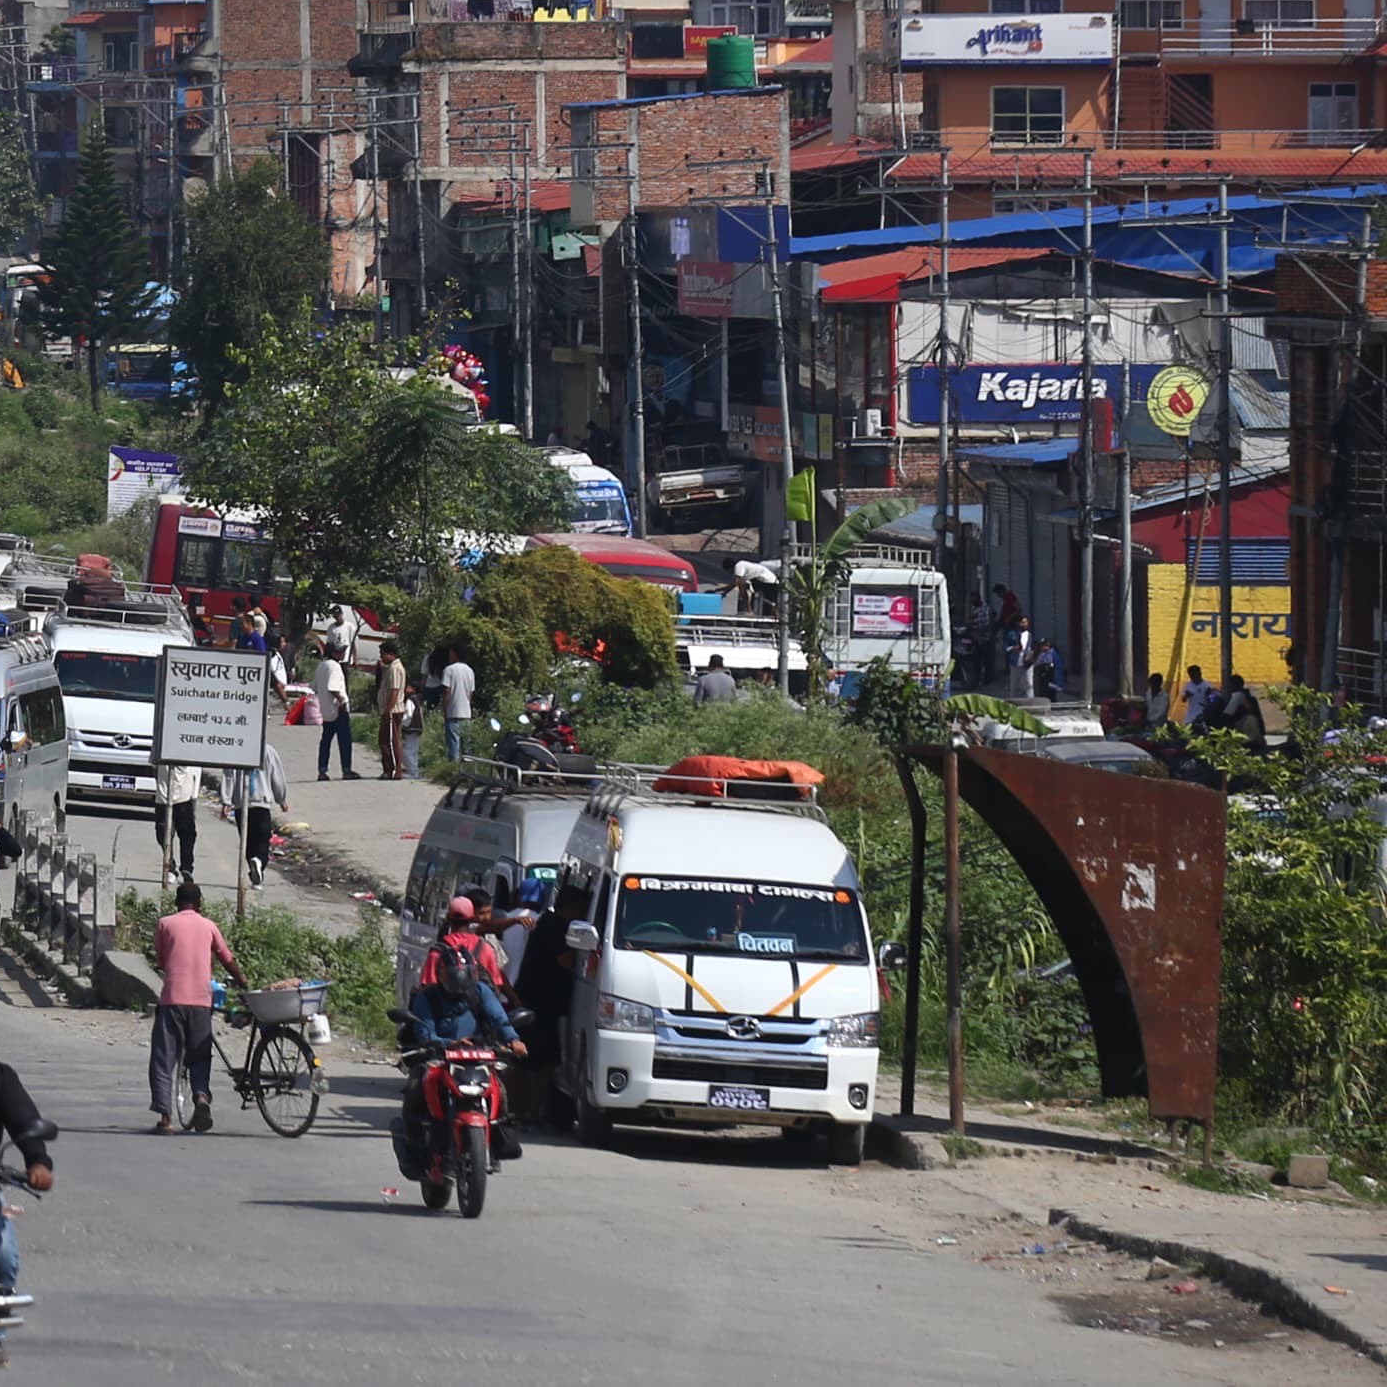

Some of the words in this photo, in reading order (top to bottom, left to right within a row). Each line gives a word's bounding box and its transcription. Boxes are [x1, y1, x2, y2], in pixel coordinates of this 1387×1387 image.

[965, 23, 1043, 56] Arihant
[170, 661, 232, 681] स्युचाटार
[237, 665, 262, 685] पुल
[171, 686, 220, 700] Suichatar
[223, 691, 258, 704] Bridge
[737, 933, 794, 954] चितवन
